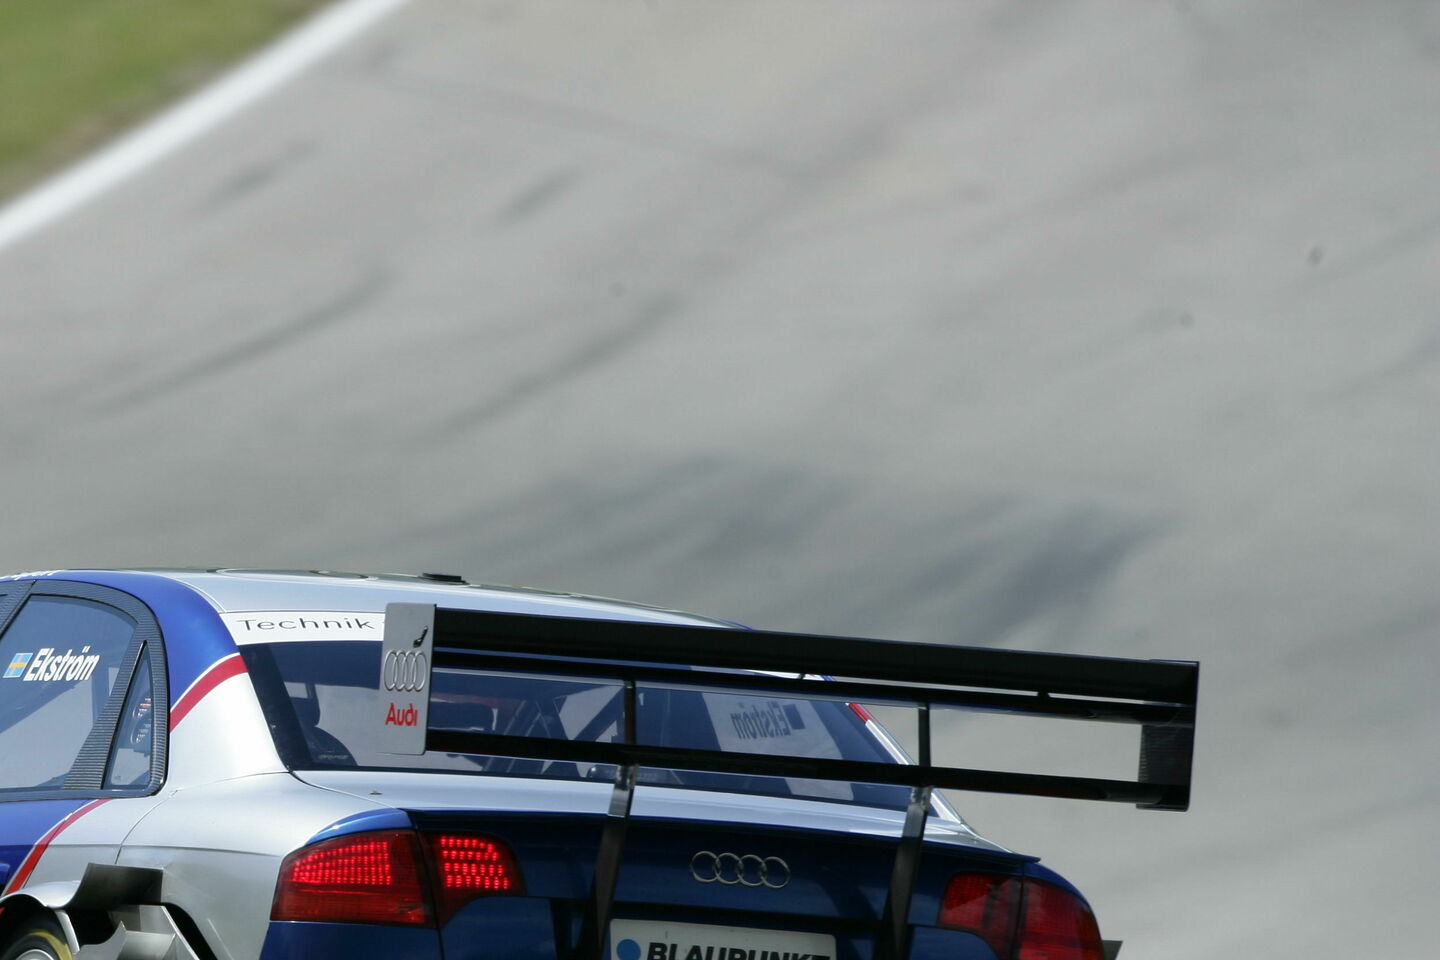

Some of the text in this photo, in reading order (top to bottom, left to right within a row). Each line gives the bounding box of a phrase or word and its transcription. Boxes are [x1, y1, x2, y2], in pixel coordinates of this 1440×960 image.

[238, 617, 375, 632] Technik
[23, 645, 100, 682] Ekström
[385, 703, 418, 727] Audi
